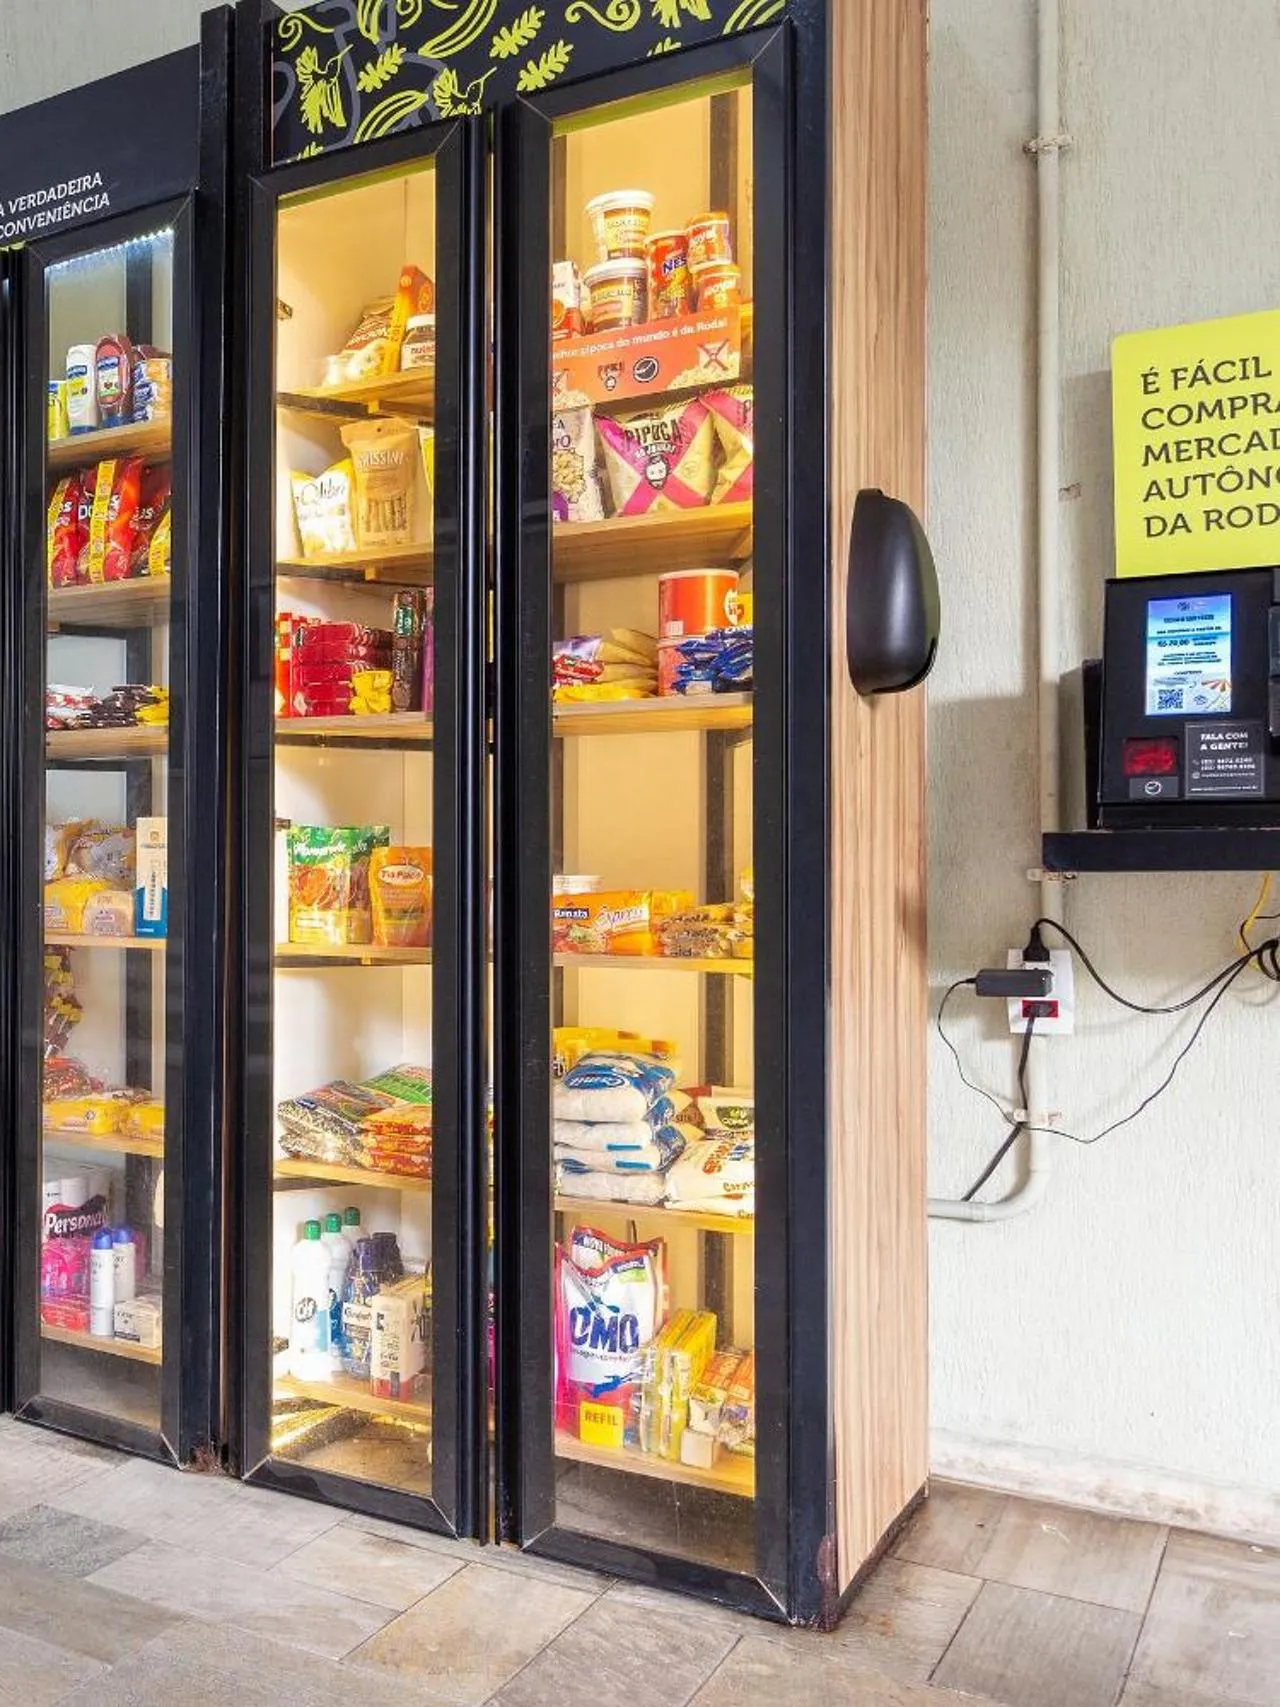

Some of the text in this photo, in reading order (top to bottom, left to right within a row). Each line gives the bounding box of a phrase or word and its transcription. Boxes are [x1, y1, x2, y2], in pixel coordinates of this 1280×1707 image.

[8, 172, 104, 214] VERDADEIRA
[1140, 355, 1273, 396] É FÁCIL
[1142, 465, 1280, 502] AUTÔN
[1143, 512, 1193, 538] DA
[584, 1410, 618, 1427] REFIL
